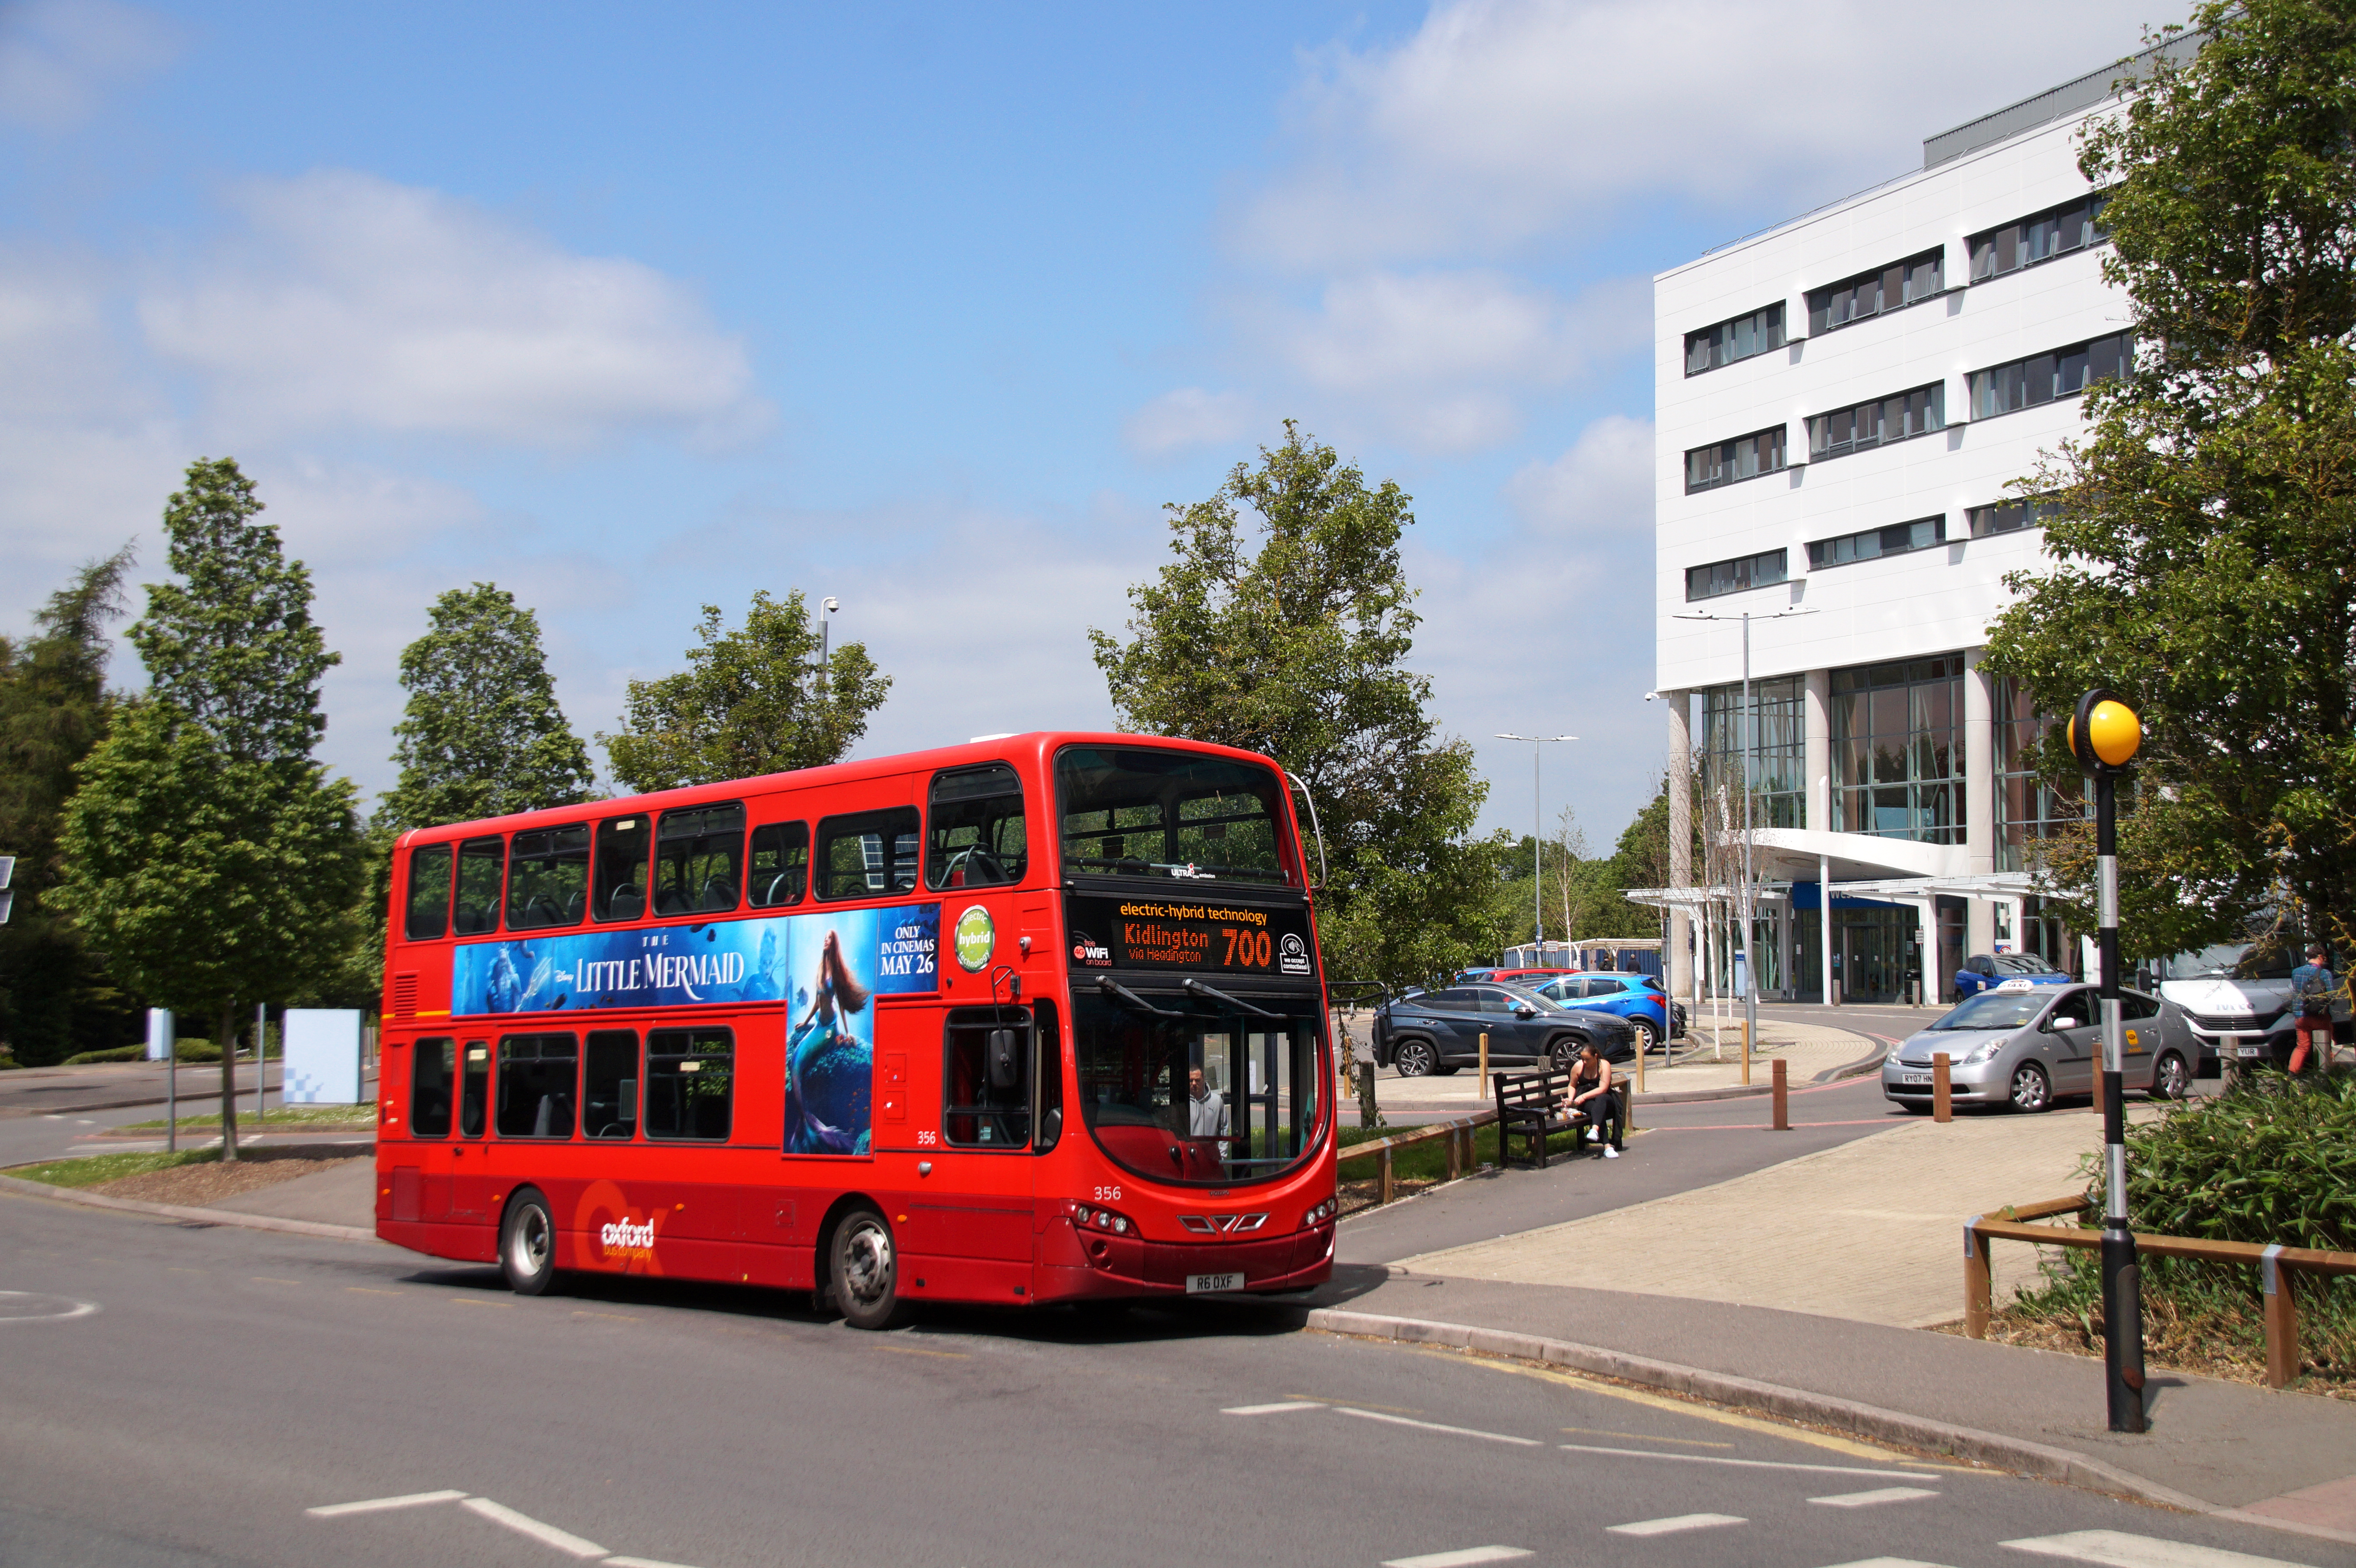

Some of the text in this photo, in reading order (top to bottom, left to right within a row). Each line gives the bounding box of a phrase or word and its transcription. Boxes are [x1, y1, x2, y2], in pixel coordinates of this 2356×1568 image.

[1171, 869, 1192, 877] ULTRA
[963, 912, 987, 926] electric
[1120, 902, 1267, 926] electric-hybrid technology
[895, 926, 921, 939] ONLY
[959, 931, 990, 947] hybrid
[1125, 923, 1208, 949] Kidlington
[642, 935, 669, 947] THE
[881, 939, 934, 954] IN CINEMAS
[1222, 929, 1271, 967] 700
[959, 949, 990, 967] technology
[1085, 947, 1108, 959] WiFi
[1129, 948, 1201, 963] via Headington
[880, 953, 934, 976] MAY 26
[576, 952, 744, 1001] LITTLE MERMAID
[918, 1131, 936, 1144] 356
[1094, 1186, 1121, 1200] 356
[601, 1216, 655, 1249] oxford
[604, 1245, 653, 1261] bus company
[1197, 1277, 1211, 1290] R6
